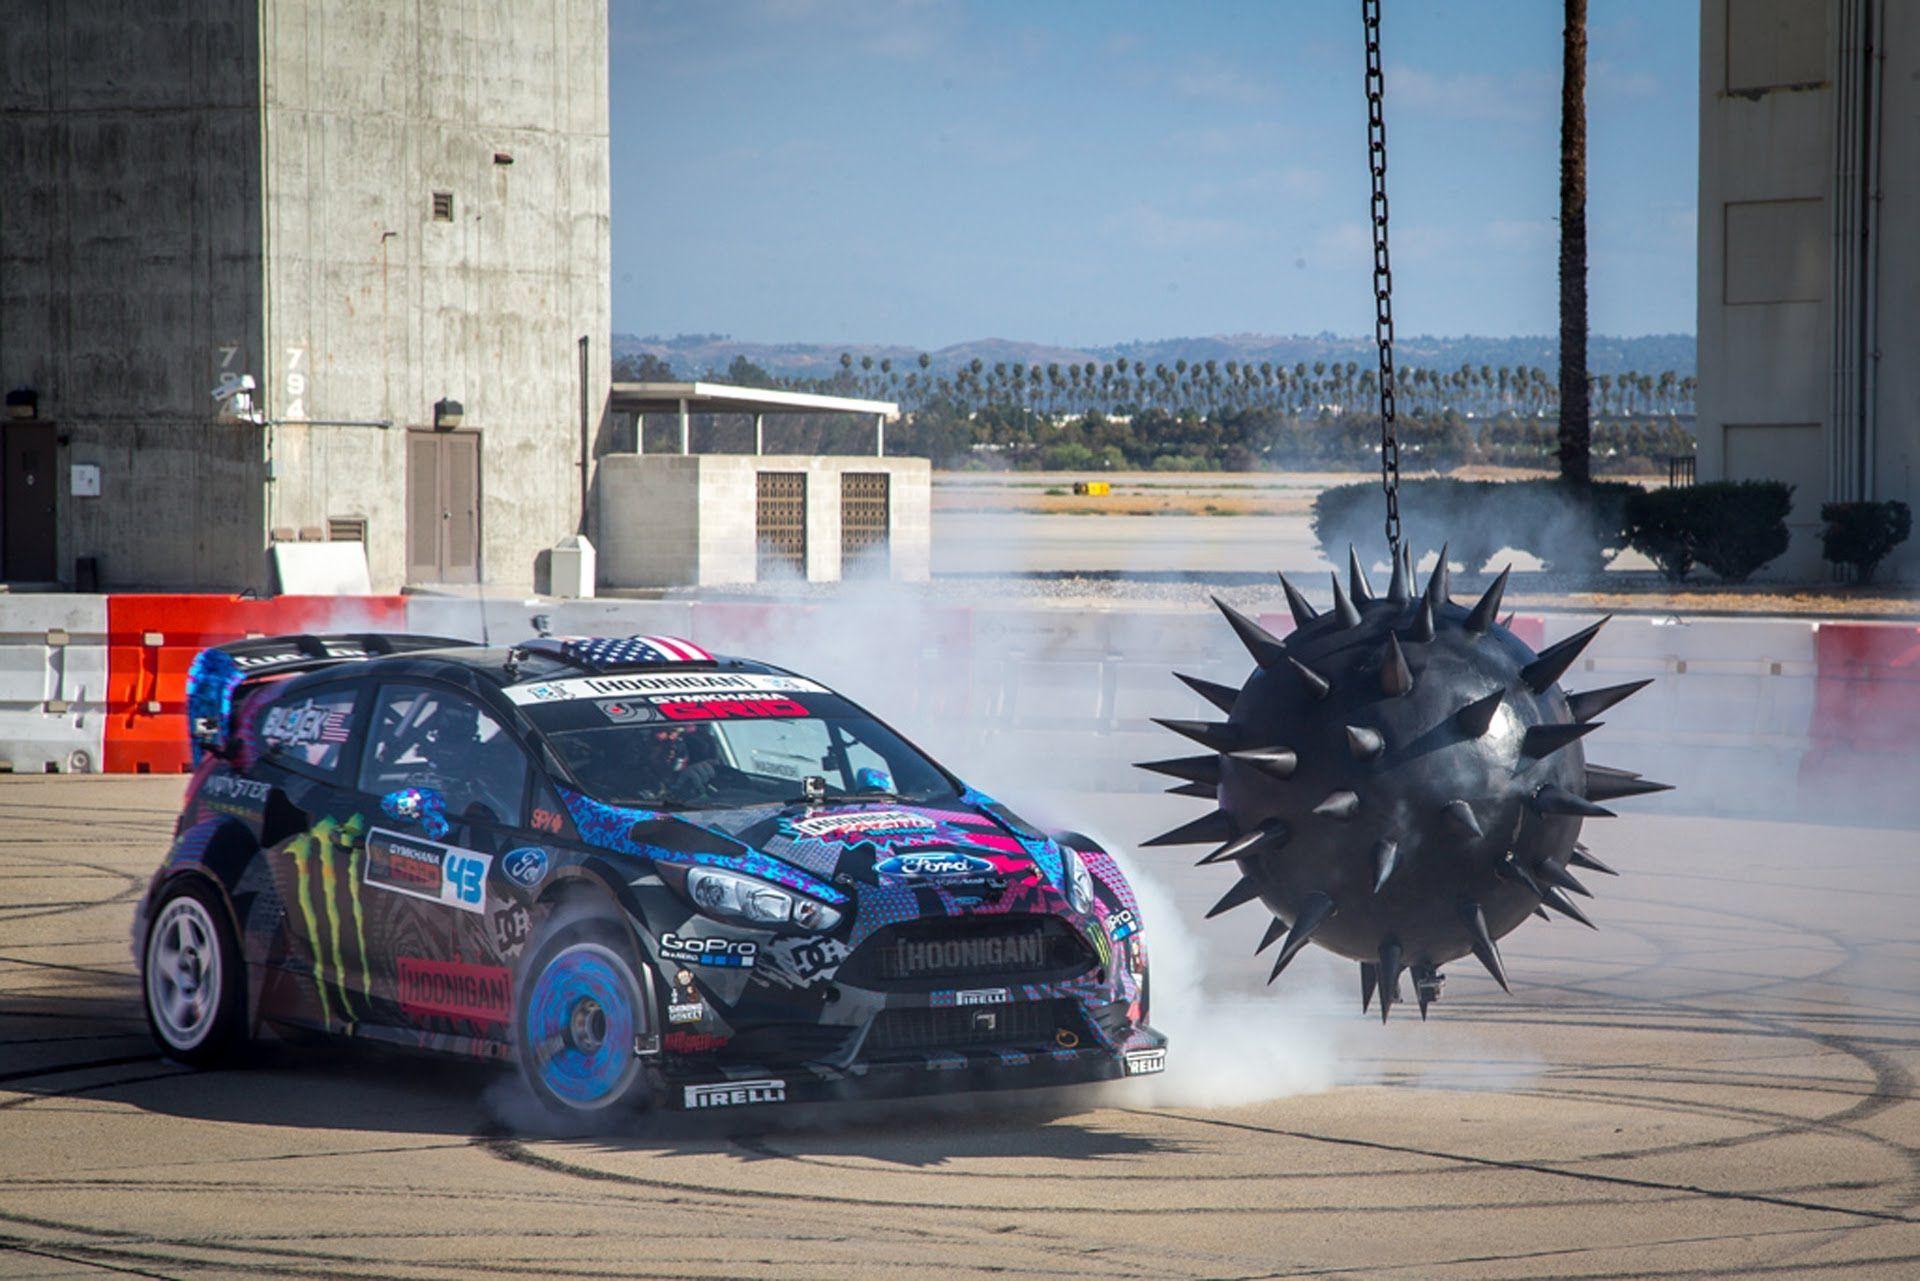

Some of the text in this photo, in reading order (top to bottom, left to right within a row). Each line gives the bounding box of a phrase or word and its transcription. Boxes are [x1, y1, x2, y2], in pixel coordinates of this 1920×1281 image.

[286, 347, 305, 418] 794
[648, 693, 789, 704] GYMKHANA
[658, 699, 810, 721] GRID
[902, 857, 975, 873] Ford
[447, 855, 484, 903] 43
[661, 933, 756, 955] GoPro
[956, 988, 1006, 1005] PIRELLI
[684, 1080, 786, 1108] PIRELLI
